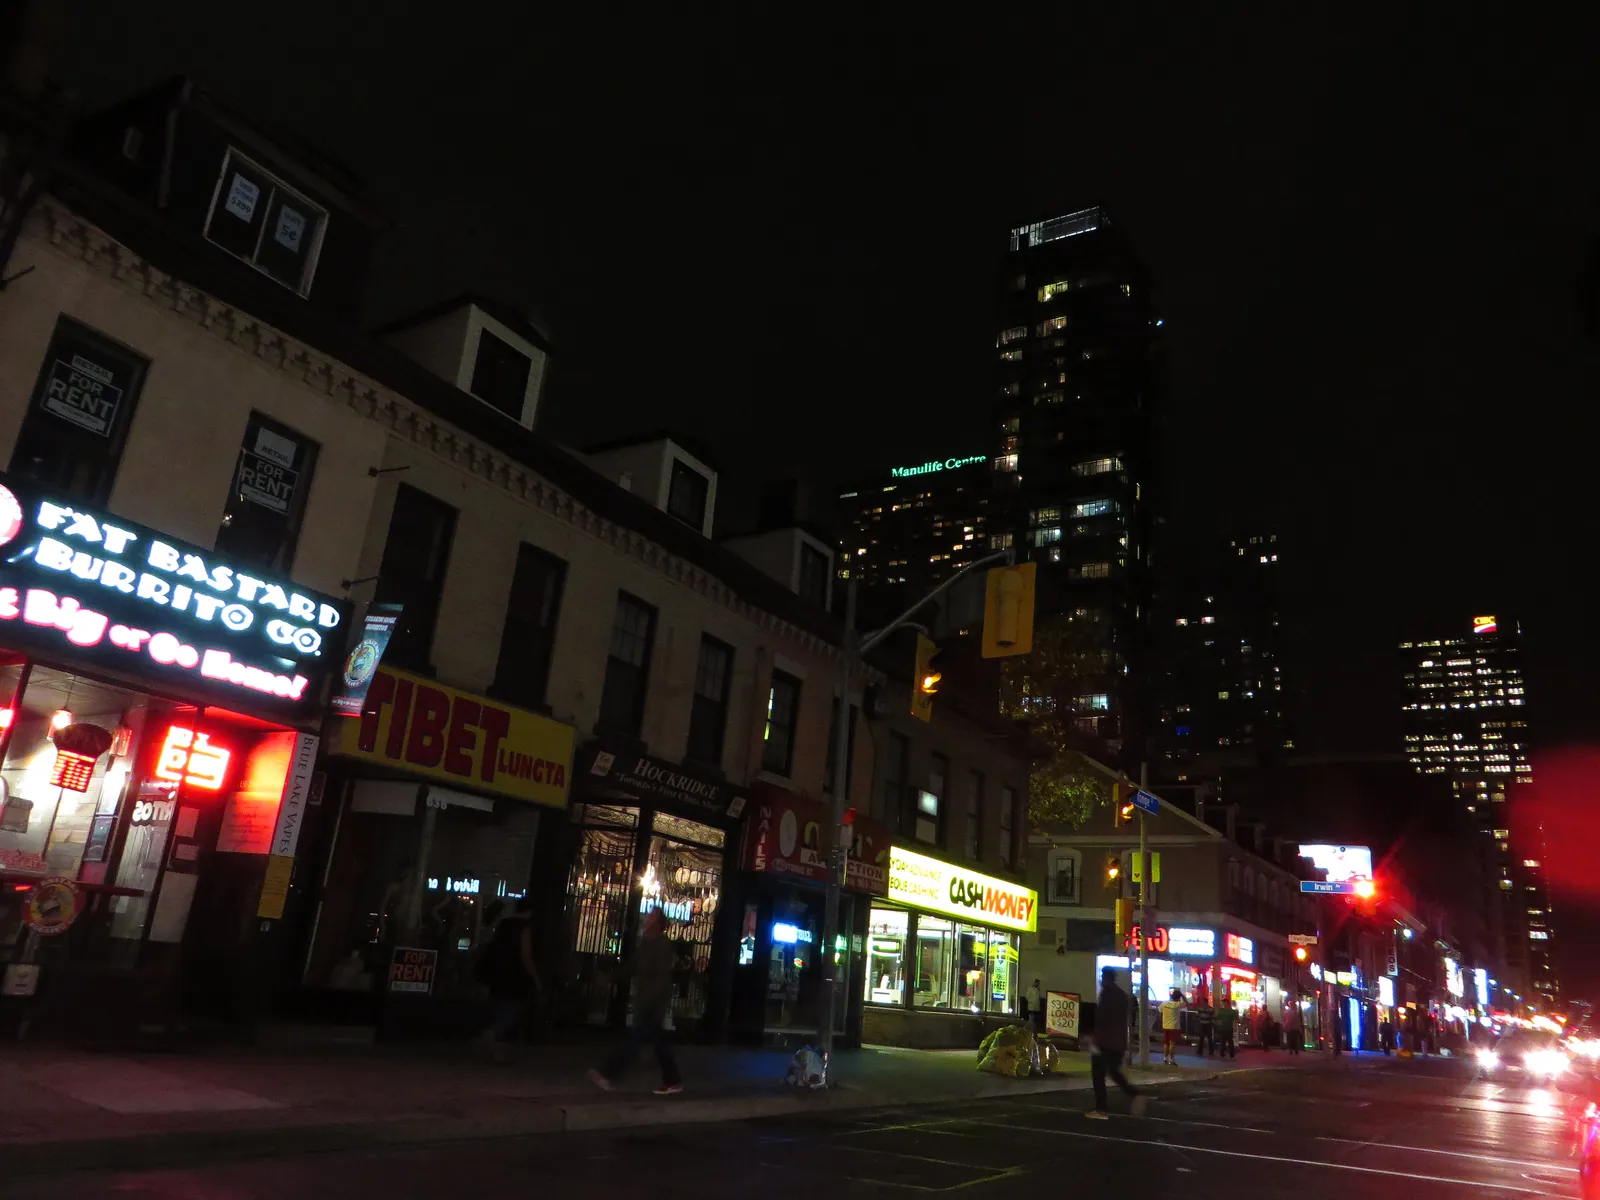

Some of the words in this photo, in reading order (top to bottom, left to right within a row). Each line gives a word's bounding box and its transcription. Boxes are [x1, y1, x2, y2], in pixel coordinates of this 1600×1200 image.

[49, 378, 115, 419] RENT
[69, 371, 104, 396] FOR
[256, 459, 285, 480] FOR
[892, 461, 943, 477] Manulife
[945, 455, 986, 469] Centre
[241, 467, 293, 500] RENT
[36, 501, 137, 554] FAT
[147, 540, 340, 628] BASTARD
[34, 536, 254, 631] BURRITO
[266, 618, 322, 657] CO.
[23, 588, 110, 647] Big
[108, 624, 151, 652] or
[358, 671, 511, 783] TIBET
[298, 737, 313, 770] BLUE
[498, 748, 565, 788] LUNGTA
[290, 775, 305, 806] LAKE
[633, 757, 720, 799] HOCKRIDGE
[279, 813, 298, 853] VAPES
[755, 805, 772, 871] NAILS
[949, 876, 984, 910] CASH
[982, 887, 1034, 922] MONEY
[1314, 882, 1332, 891] Irwin
[391, 963, 433, 982] RENT
[404, 952, 426, 964] FOR
[993, 979, 1006, 991] FREE
[1051, 1000, 1075, 1011] $300
[1051, 1010, 1075, 1019] LOAN
[1057, 1018, 1074, 1028] $20
